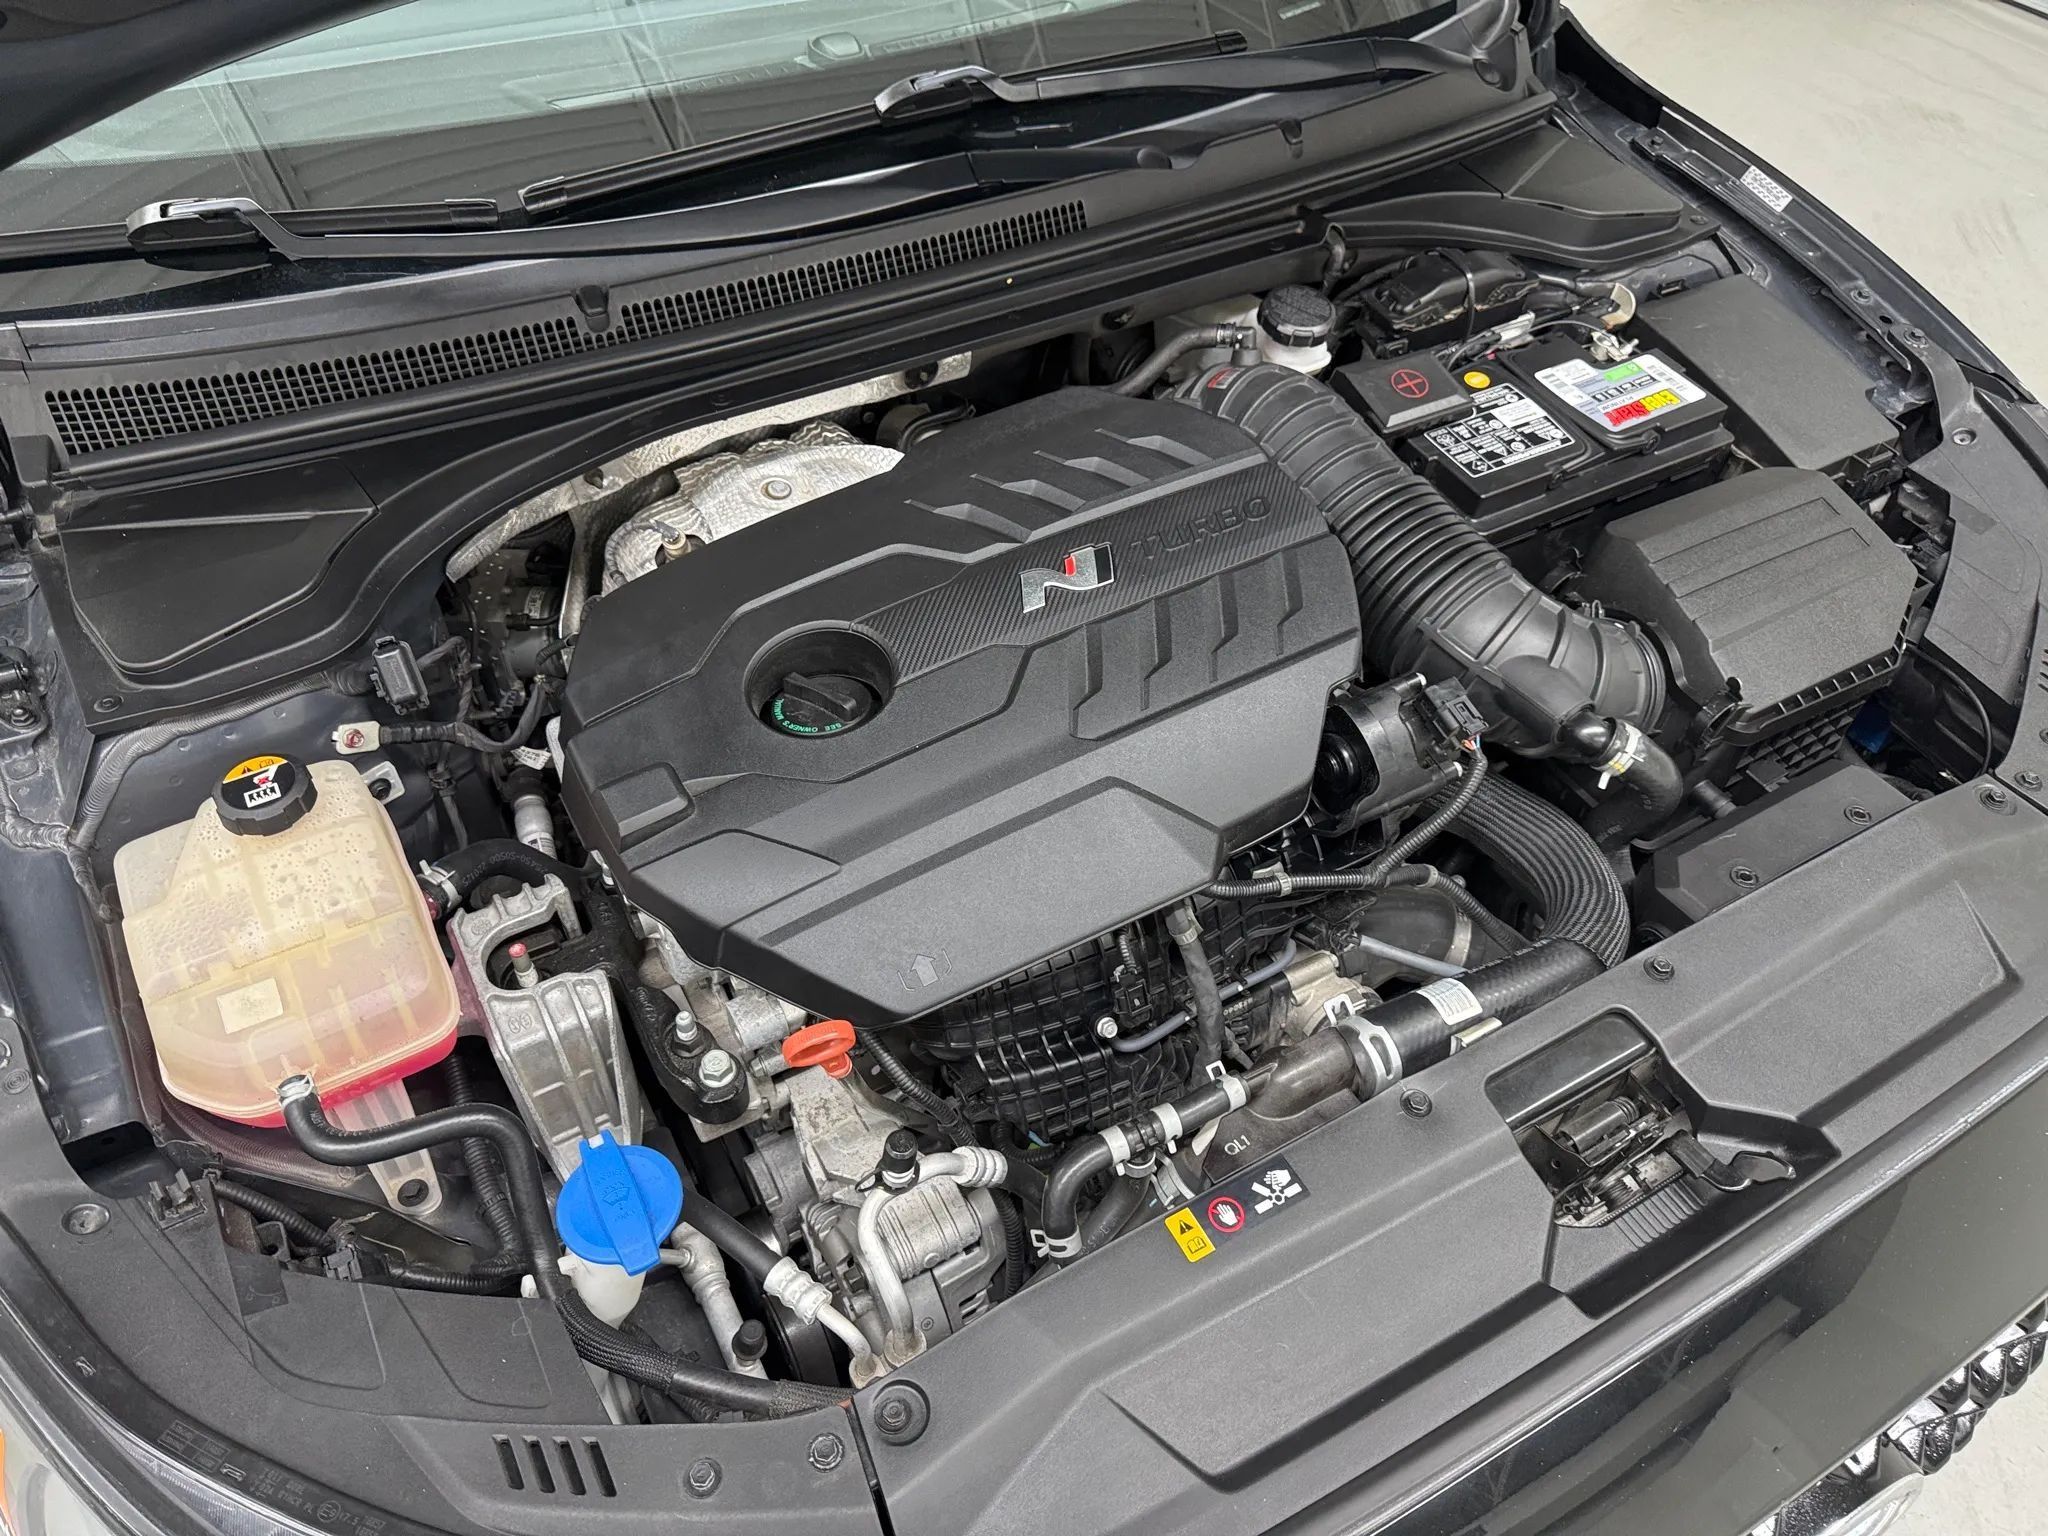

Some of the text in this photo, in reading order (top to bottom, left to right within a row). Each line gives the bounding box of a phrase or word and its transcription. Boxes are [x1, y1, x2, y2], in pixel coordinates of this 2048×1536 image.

[1603, 388, 1680, 426] EverStart
[1130, 496, 1272, 560] TURBO
[774, 698, 842, 732] SEE OWNER'S MANUAL
[1224, 1134, 1251, 1156] QL1
